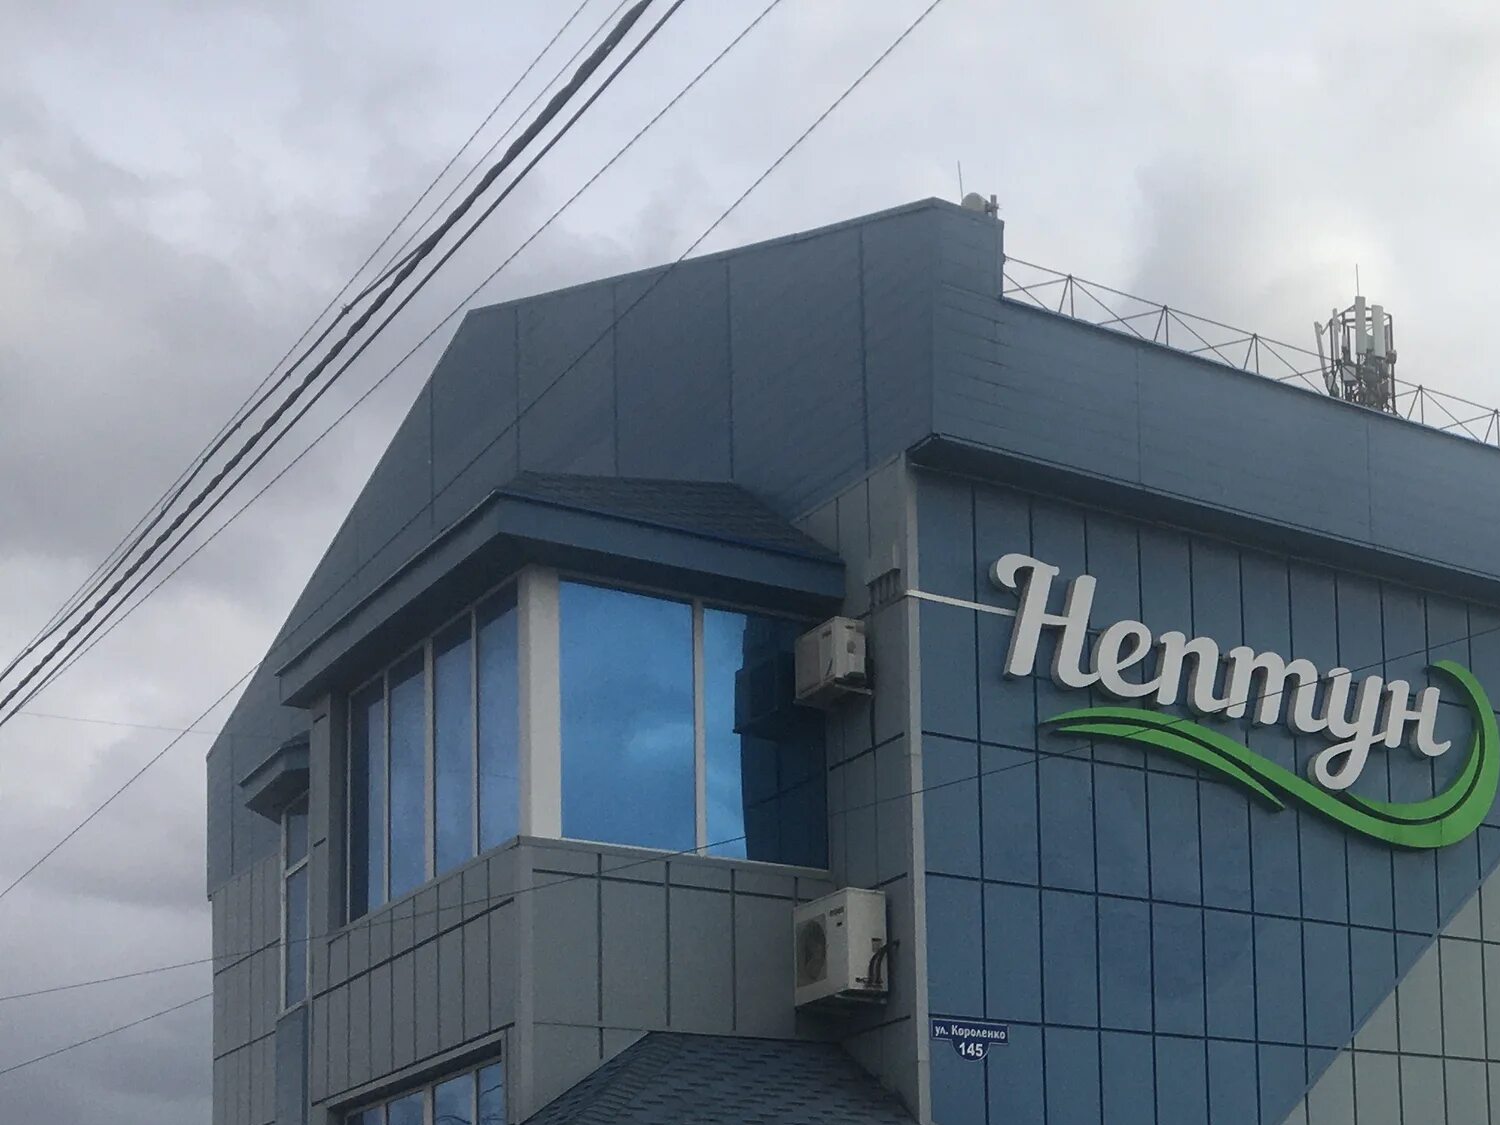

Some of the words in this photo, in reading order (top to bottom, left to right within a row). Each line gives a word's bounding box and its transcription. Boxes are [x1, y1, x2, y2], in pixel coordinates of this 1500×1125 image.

[989, 552, 1452, 791] Нептун
[934, 1025, 949, 1037] ул.
[951, 1024, 1006, 1040] Короленко
[959, 1041, 984, 1057] 145
